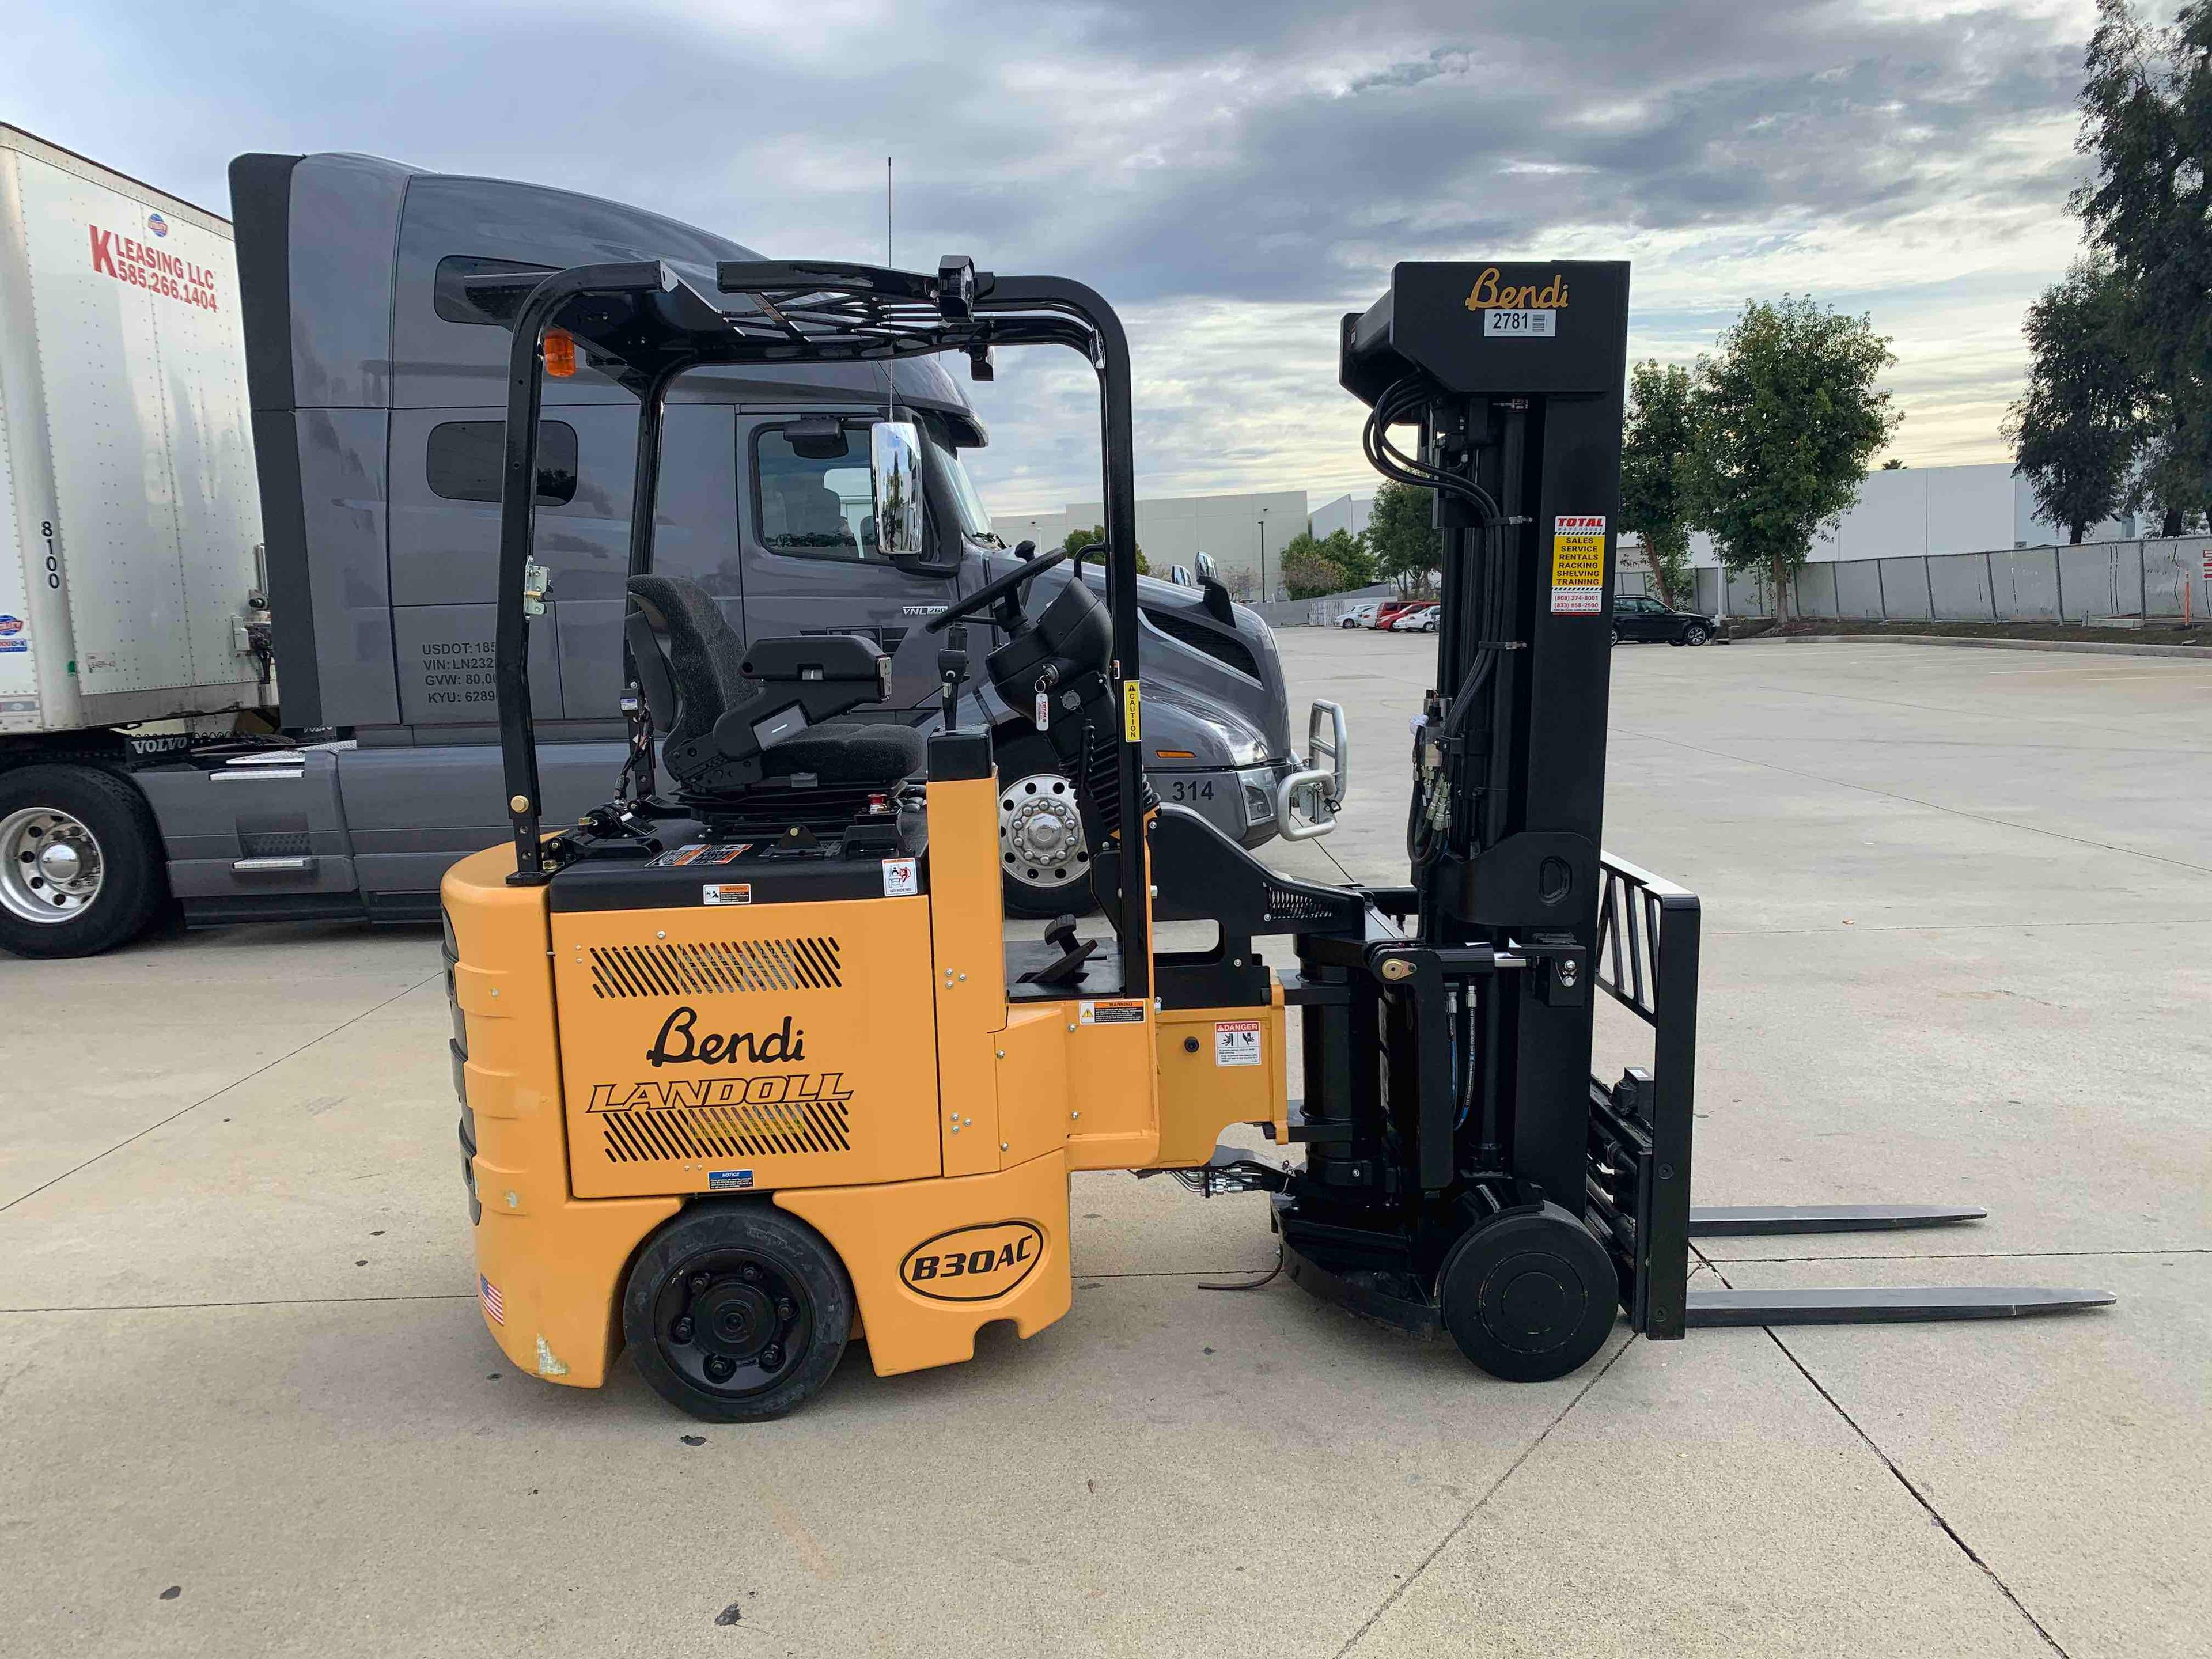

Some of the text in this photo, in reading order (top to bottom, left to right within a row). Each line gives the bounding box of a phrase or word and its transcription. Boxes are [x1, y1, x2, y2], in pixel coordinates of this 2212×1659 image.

[115, 234, 184, 279] LEASING
[187, 262, 214, 290] LLC
[118, 260, 218, 313] 585.266.1404
[1465, 267, 1569, 311] Bendi
[1493, 312, 1528, 329] 2781
[1557, 518, 1604, 527] TOTAL
[41, 521, 59, 589] 8100
[902, 607, 927, 615] VNL
[422, 643, 473, 655] USDOT:
[423, 658, 494, 670] VIN: LN232
[425, 675, 461, 685] GVW:
[428, 691, 495, 703] KYU: 6289
[131, 737, 188, 755] VOLVO
[1172, 780, 1215, 801] 314
[646, 1006, 805, 1067] Bendi
[585, 1072, 854, 1113] LANDOLL
[911, 1234, 1033, 1282] B30AC
